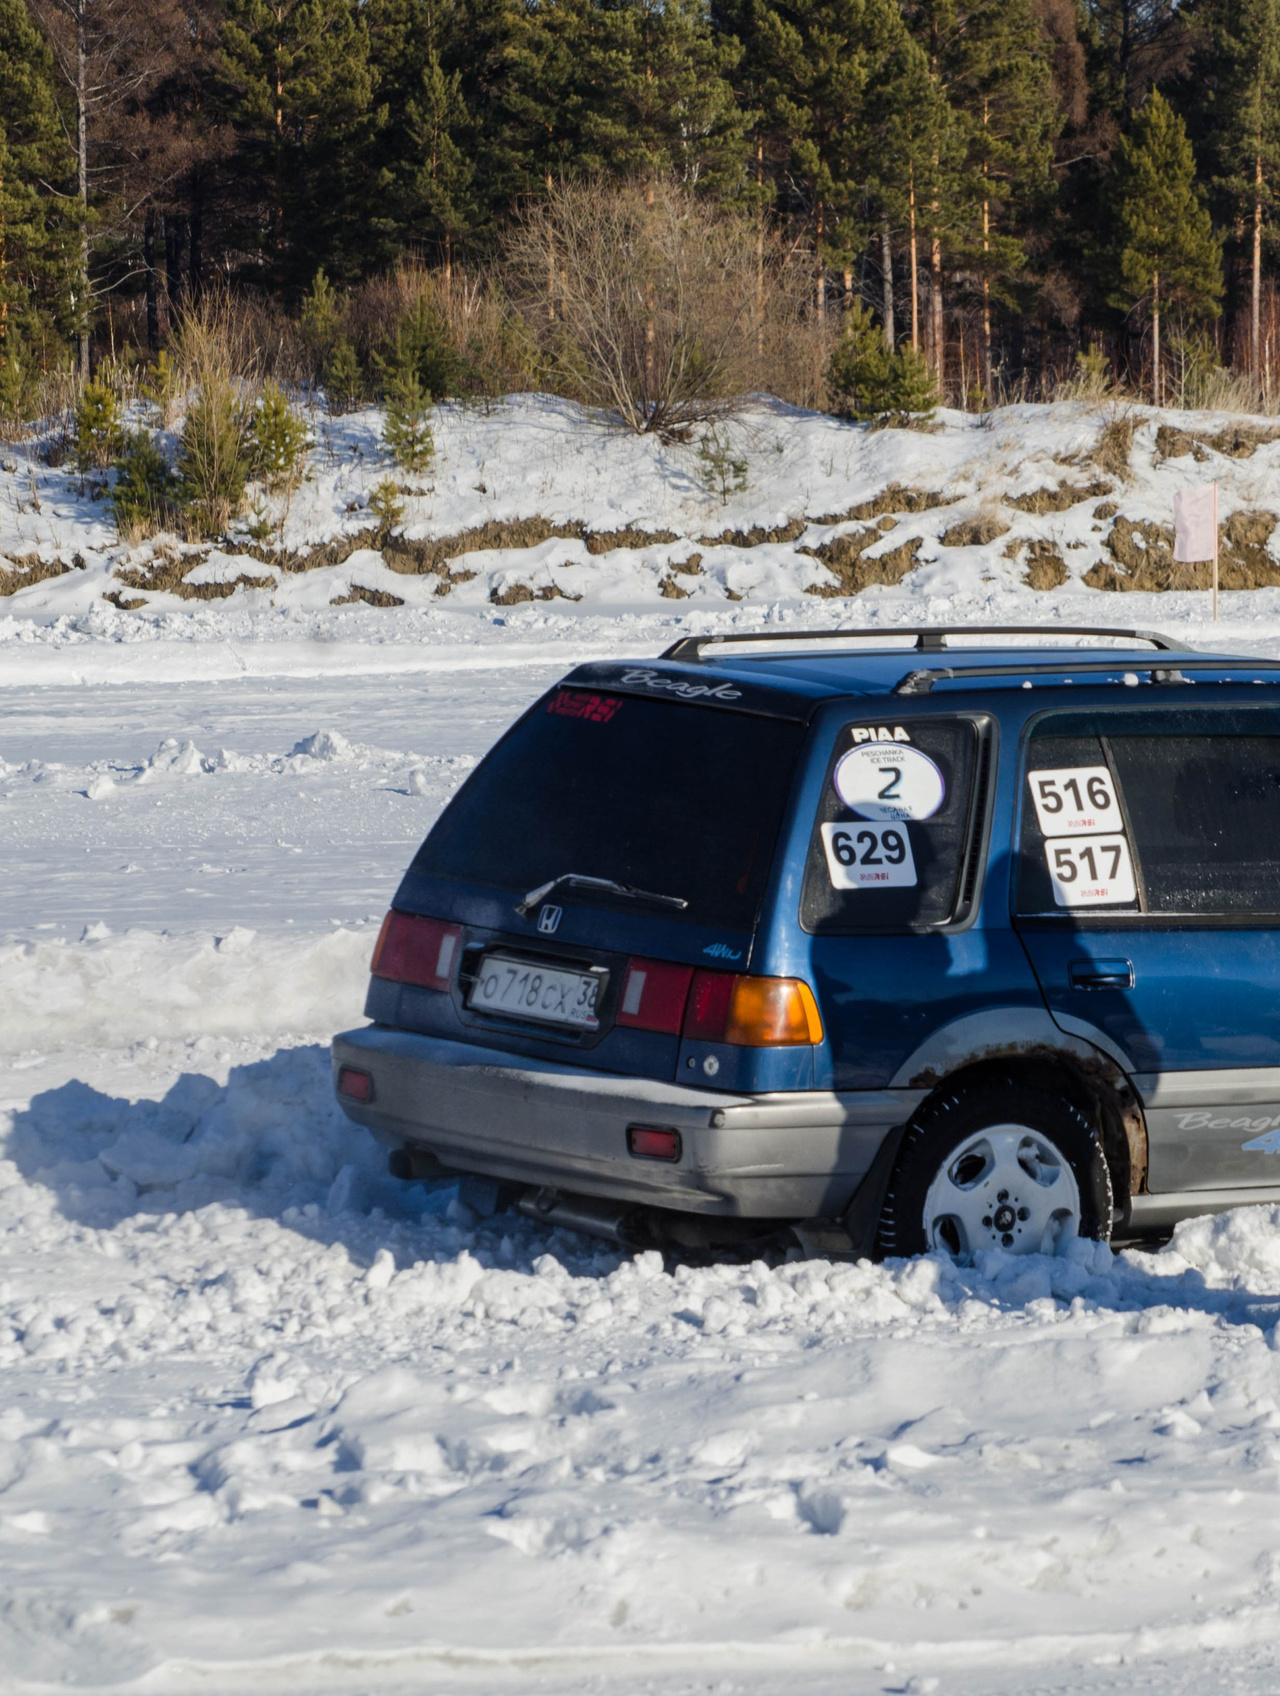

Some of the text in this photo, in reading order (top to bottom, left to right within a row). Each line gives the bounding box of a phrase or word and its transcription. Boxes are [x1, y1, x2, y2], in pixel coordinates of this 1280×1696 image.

[620, 668, 743, 700] Beagle
[850, 726, 911, 743] PIAA
[860, 748, 905, 758] PESCHANKA
[882, 755, 906, 764] TRACK
[877, 767, 903, 800] 2
[1038, 776, 1111, 814] 516
[832, 829, 906, 867] 629
[1054, 845, 1122, 883] 517
[577, 980, 599, 1009] 38
[570, 1007, 588, 1020] RUS
